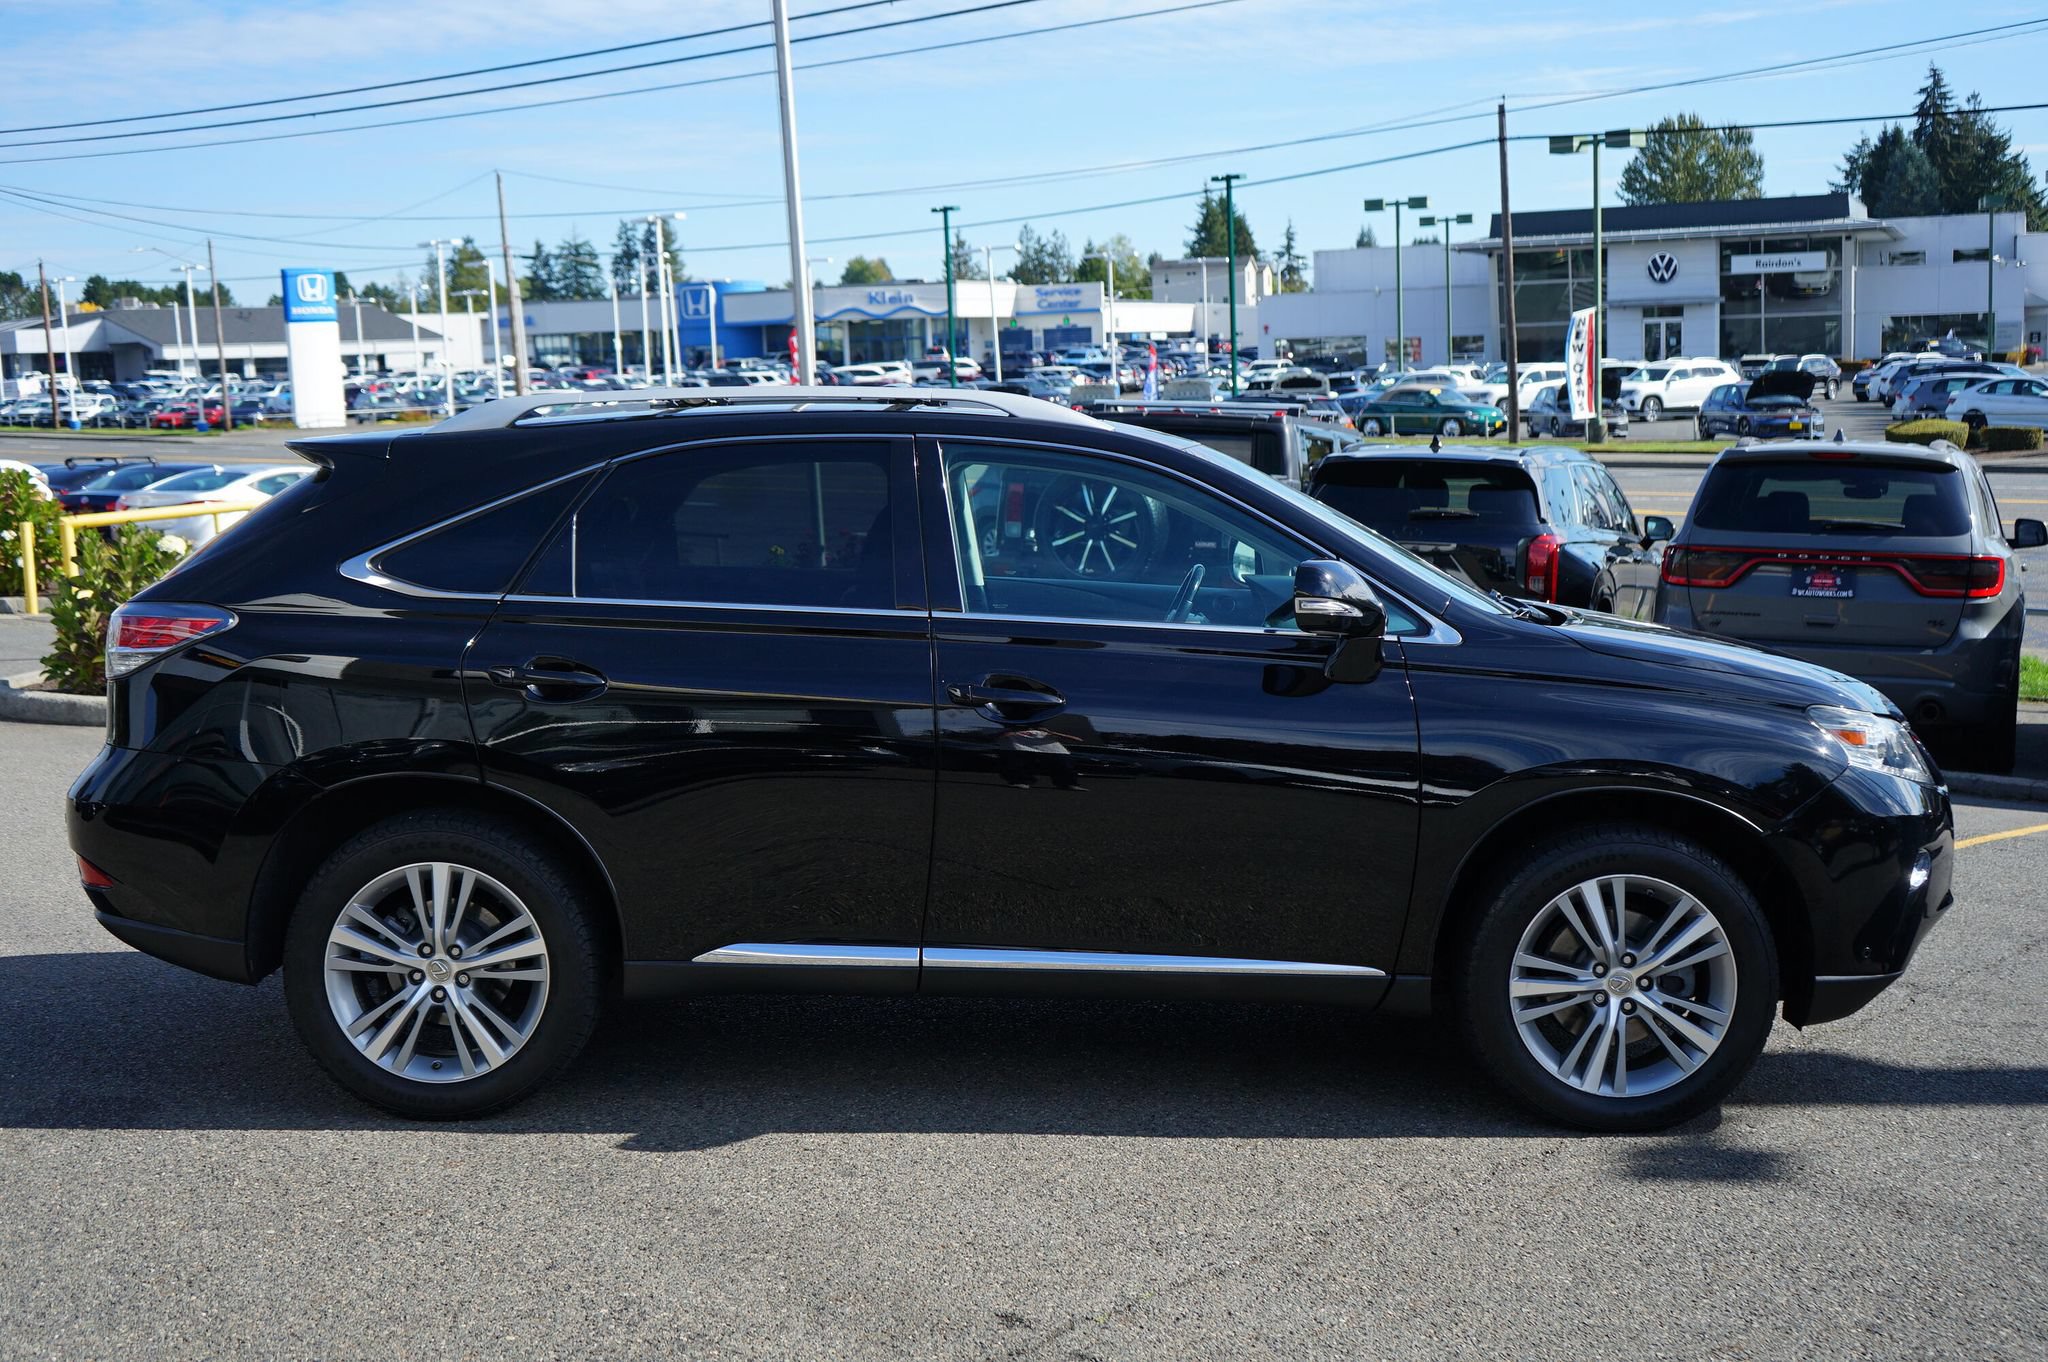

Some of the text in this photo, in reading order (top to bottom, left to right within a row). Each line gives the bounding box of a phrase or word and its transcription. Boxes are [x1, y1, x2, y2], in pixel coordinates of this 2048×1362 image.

[1755, 257, 1802, 269] Rairdon's
[1035, 287, 1082, 297] Service
[867, 290, 914, 305] Klein
[1036, 299, 1081, 309] Center
[291, 306, 335, 315] HONDA
[1777, 552, 1872, 562] DODGE
